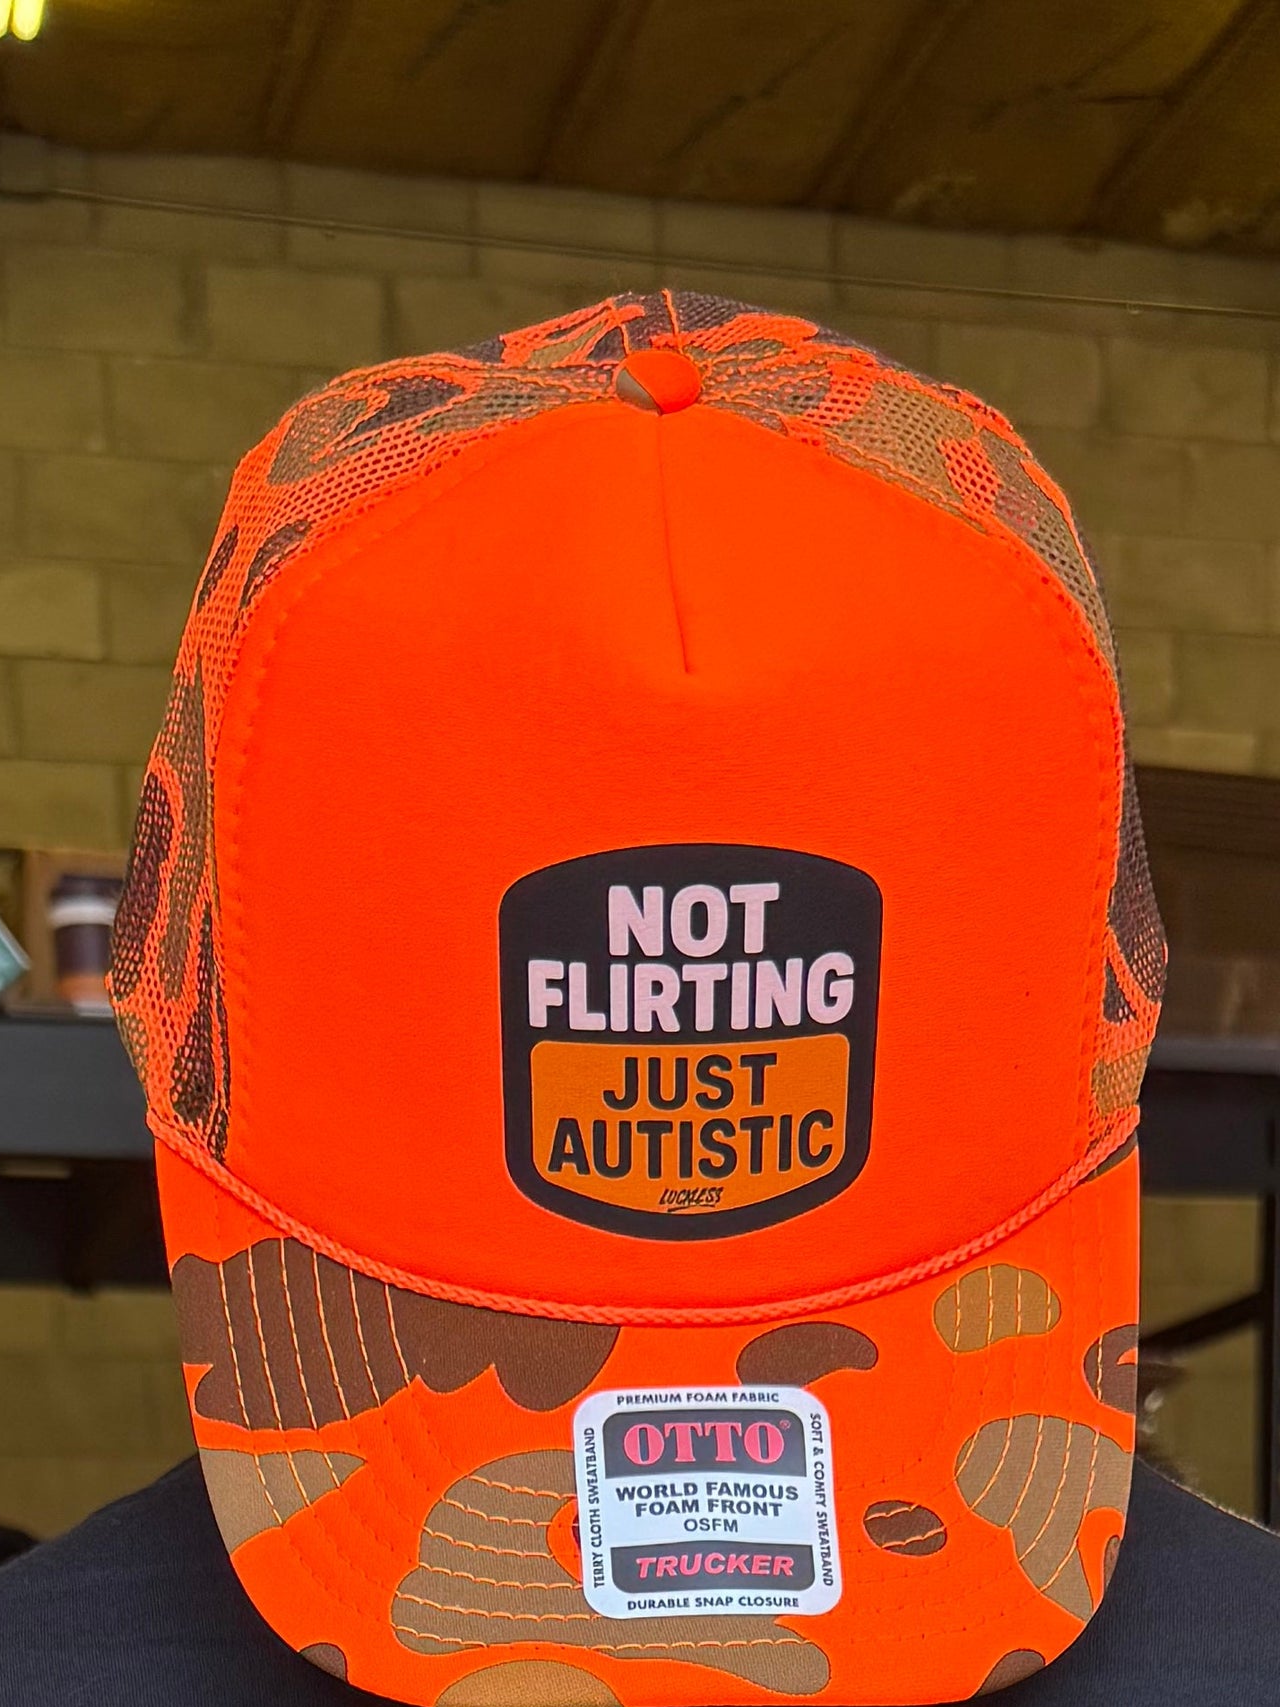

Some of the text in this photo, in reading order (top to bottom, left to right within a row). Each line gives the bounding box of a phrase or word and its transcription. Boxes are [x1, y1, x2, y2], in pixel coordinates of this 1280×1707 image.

[609, 883, 779, 957] NOT
[528, 952, 854, 1031] FLIRTING
[603, 1053, 777, 1110] JUST
[548, 1109, 833, 1179] AUTISTIC
[617, 1392, 780, 1405] PREMIUM FOAM FABRIC
[584, 1427, 605, 1588] TERRY CLOTH SWEATBAND
[616, 1482, 799, 1501] WORLD FAMOUS
[635, 1499, 782, 1517] FOAM FRONT
[810, 1413, 834, 1587] SOFT & COMFY SWEATBAND
[684, 1518, 739, 1533] OSFM
[636, 1552, 795, 1579] TRUCKER
[627, 1596, 799, 1611] DURABLE SNAP CLOSURE
